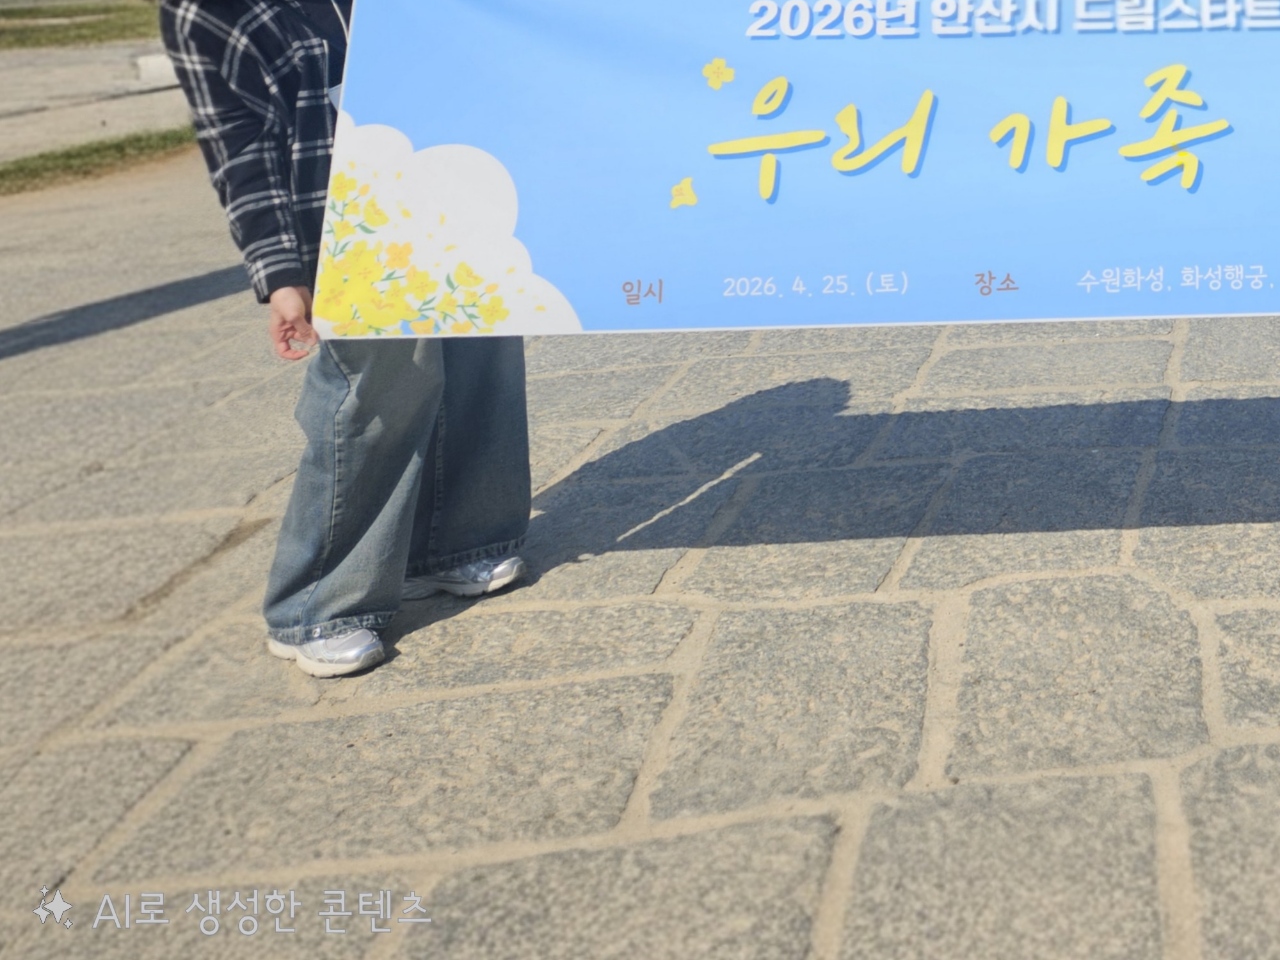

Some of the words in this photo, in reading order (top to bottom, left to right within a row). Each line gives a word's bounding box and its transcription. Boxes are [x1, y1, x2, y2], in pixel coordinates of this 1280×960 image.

[707, 76, 935, 204] 우리
[989, 63, 1234, 192] 가족
[621, 278, 665, 305] 일시
[723, 275, 784, 298] 2026.
[791, 274, 812, 297] 4.
[822, 274, 855, 297] 25.
[866, 270, 908, 295] (토)
[974, 270, 1020, 296] 장소
